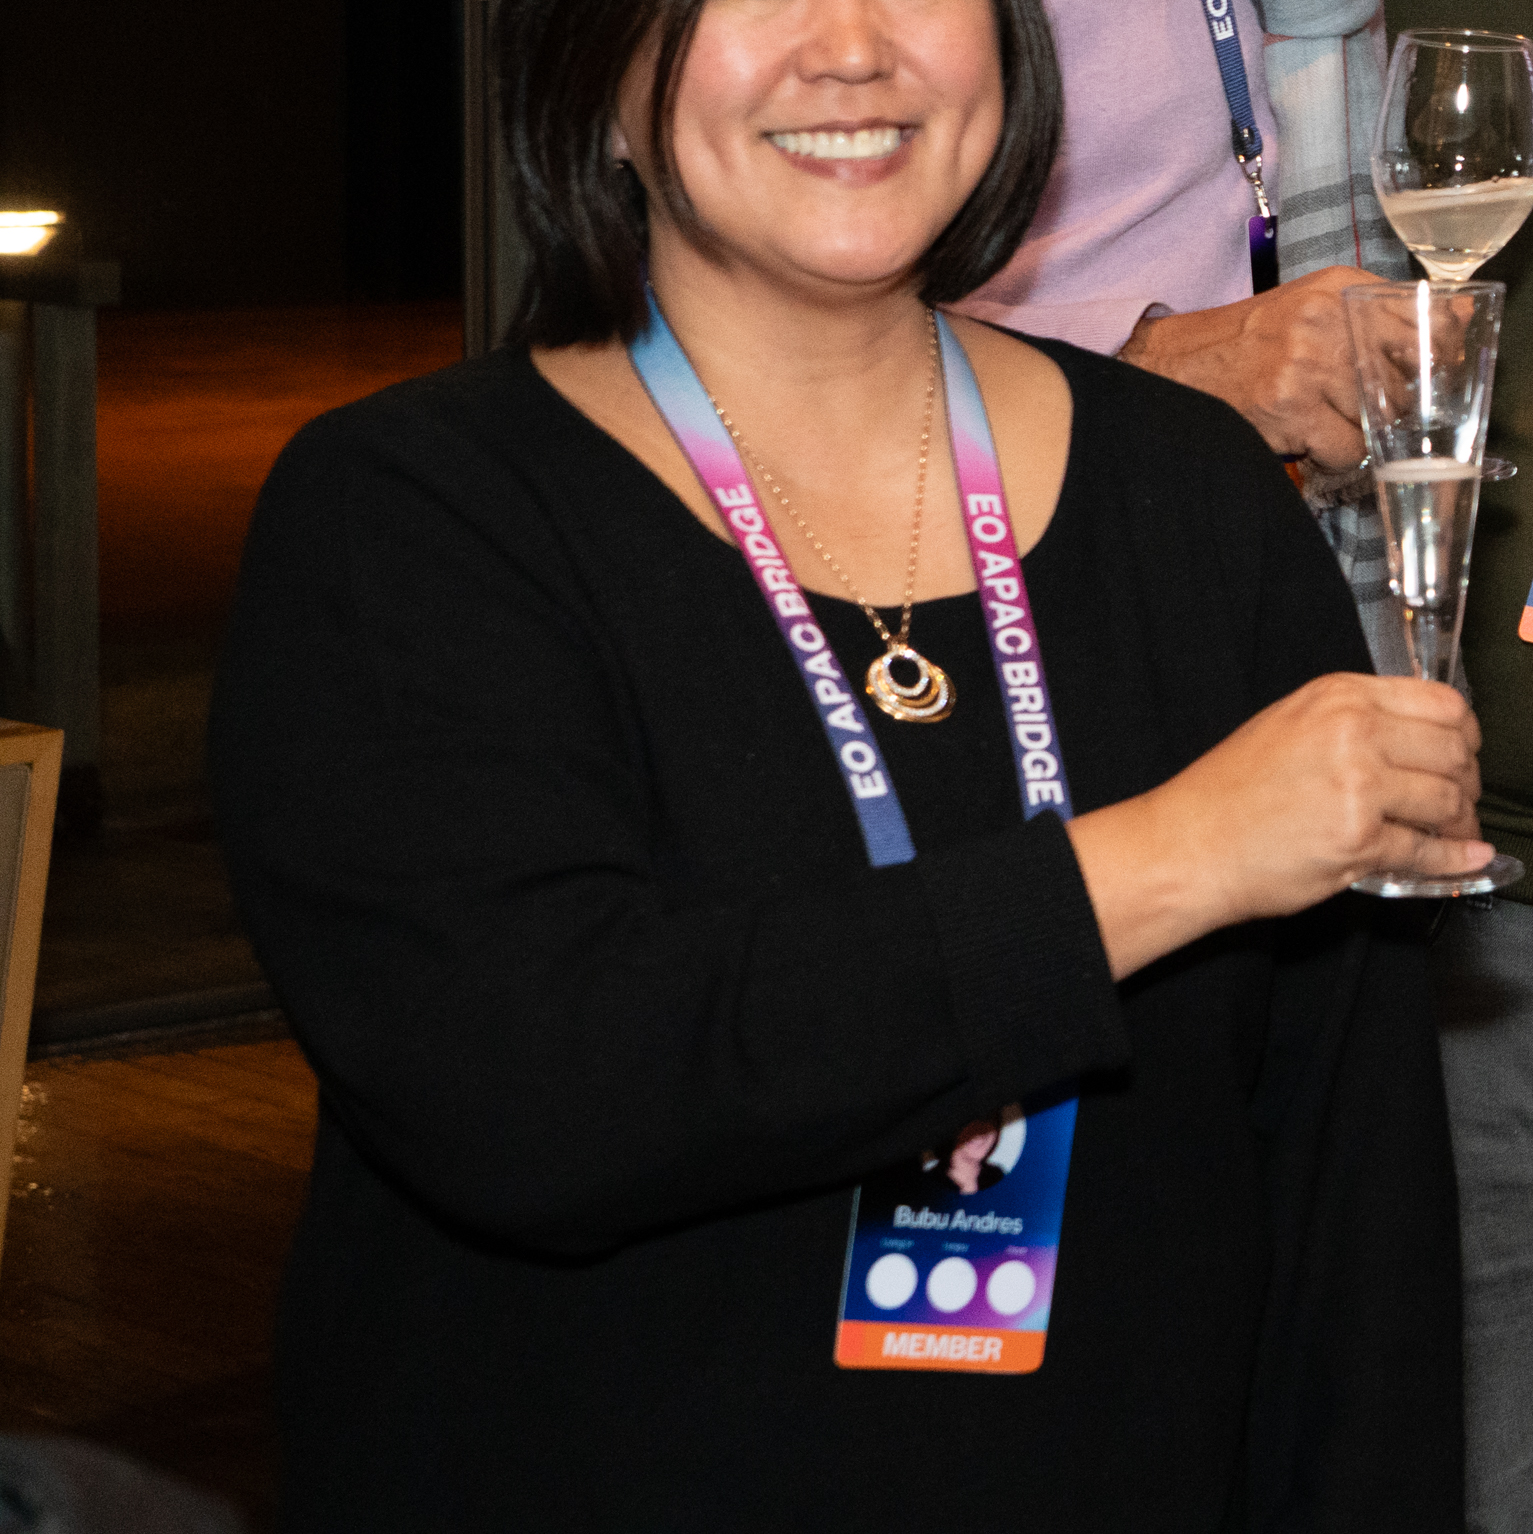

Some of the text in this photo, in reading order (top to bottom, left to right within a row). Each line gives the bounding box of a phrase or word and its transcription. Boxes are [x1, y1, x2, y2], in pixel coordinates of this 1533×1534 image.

[715, 482, 888, 800] EO APAC BRIDGE
[967, 492, 1065, 807] EO APAC BRIDGE
[892, 1204, 1024, 1235] Bubu Andres
[881, 1332, 1004, 1362] MEMBER
